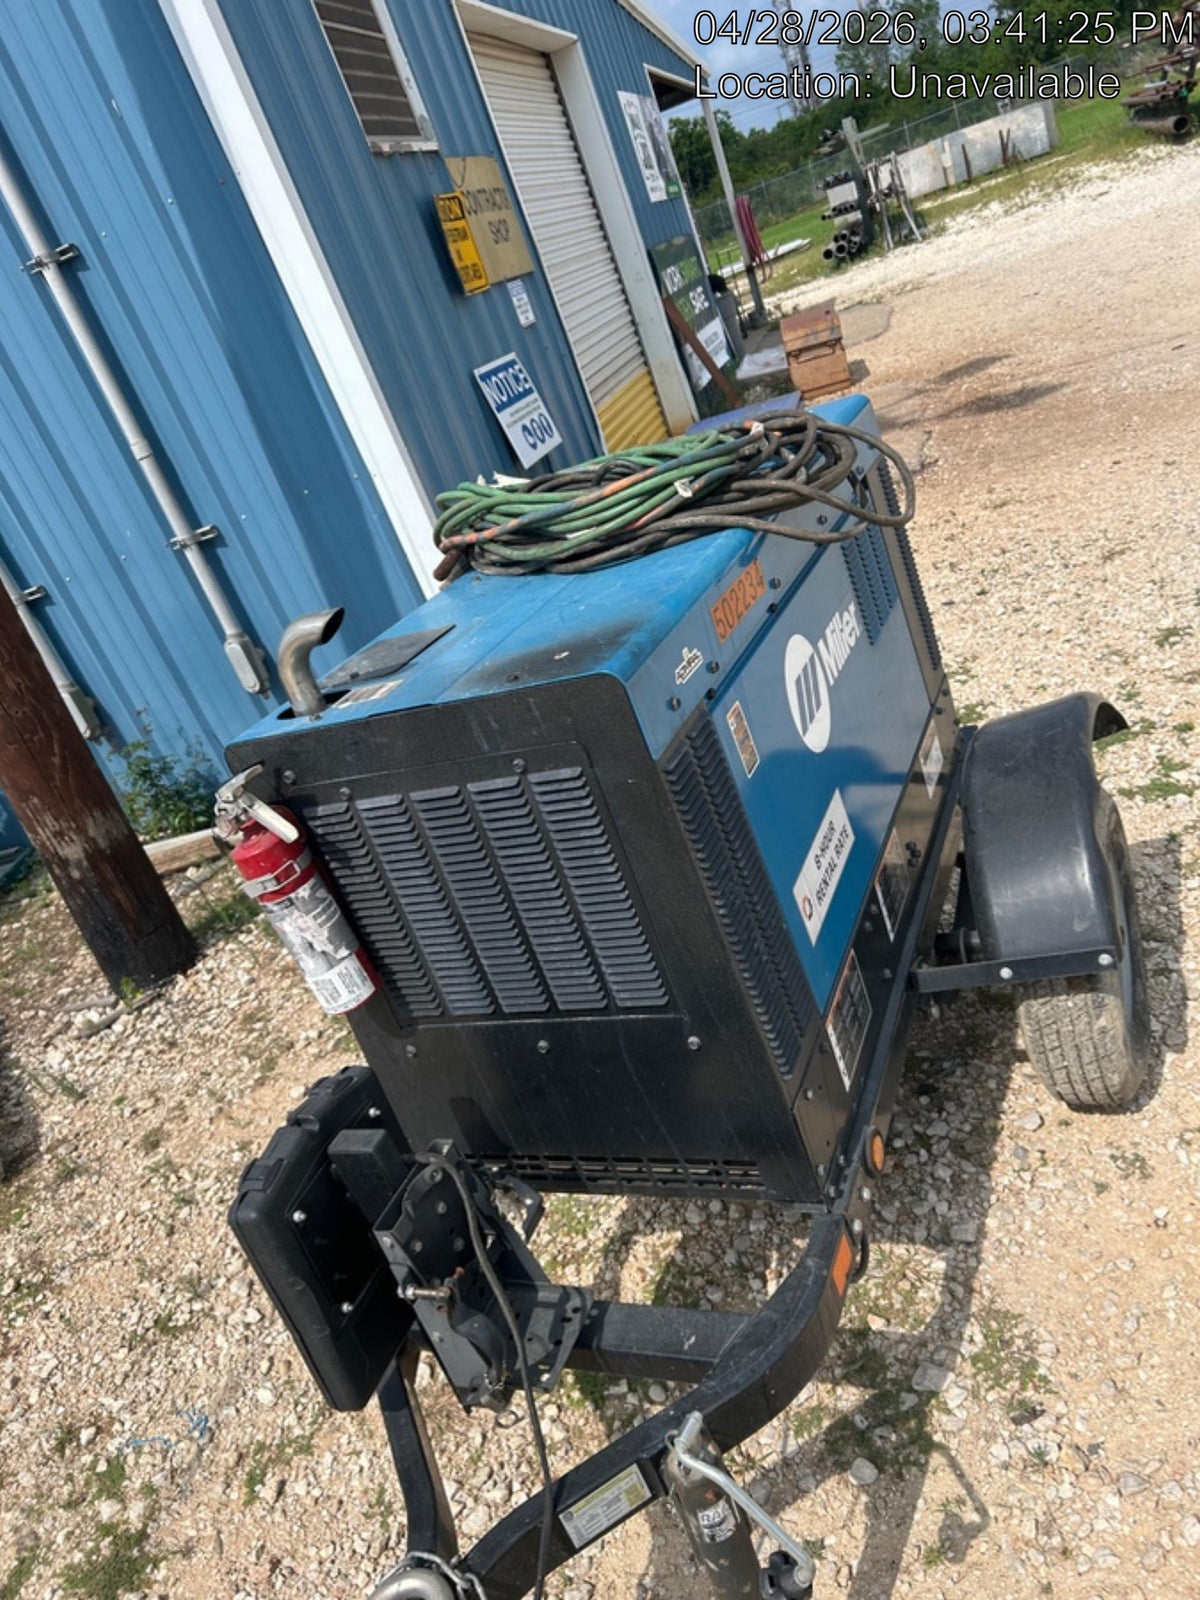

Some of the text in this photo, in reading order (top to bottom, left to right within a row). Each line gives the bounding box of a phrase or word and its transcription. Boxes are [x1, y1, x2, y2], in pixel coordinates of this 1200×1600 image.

[482, 364, 531, 405] NOTICE
[711, 557, 765, 640] 502234
[817, 601, 861, 687] Miller
[815, 824, 850, 907] RENTAL RATE
